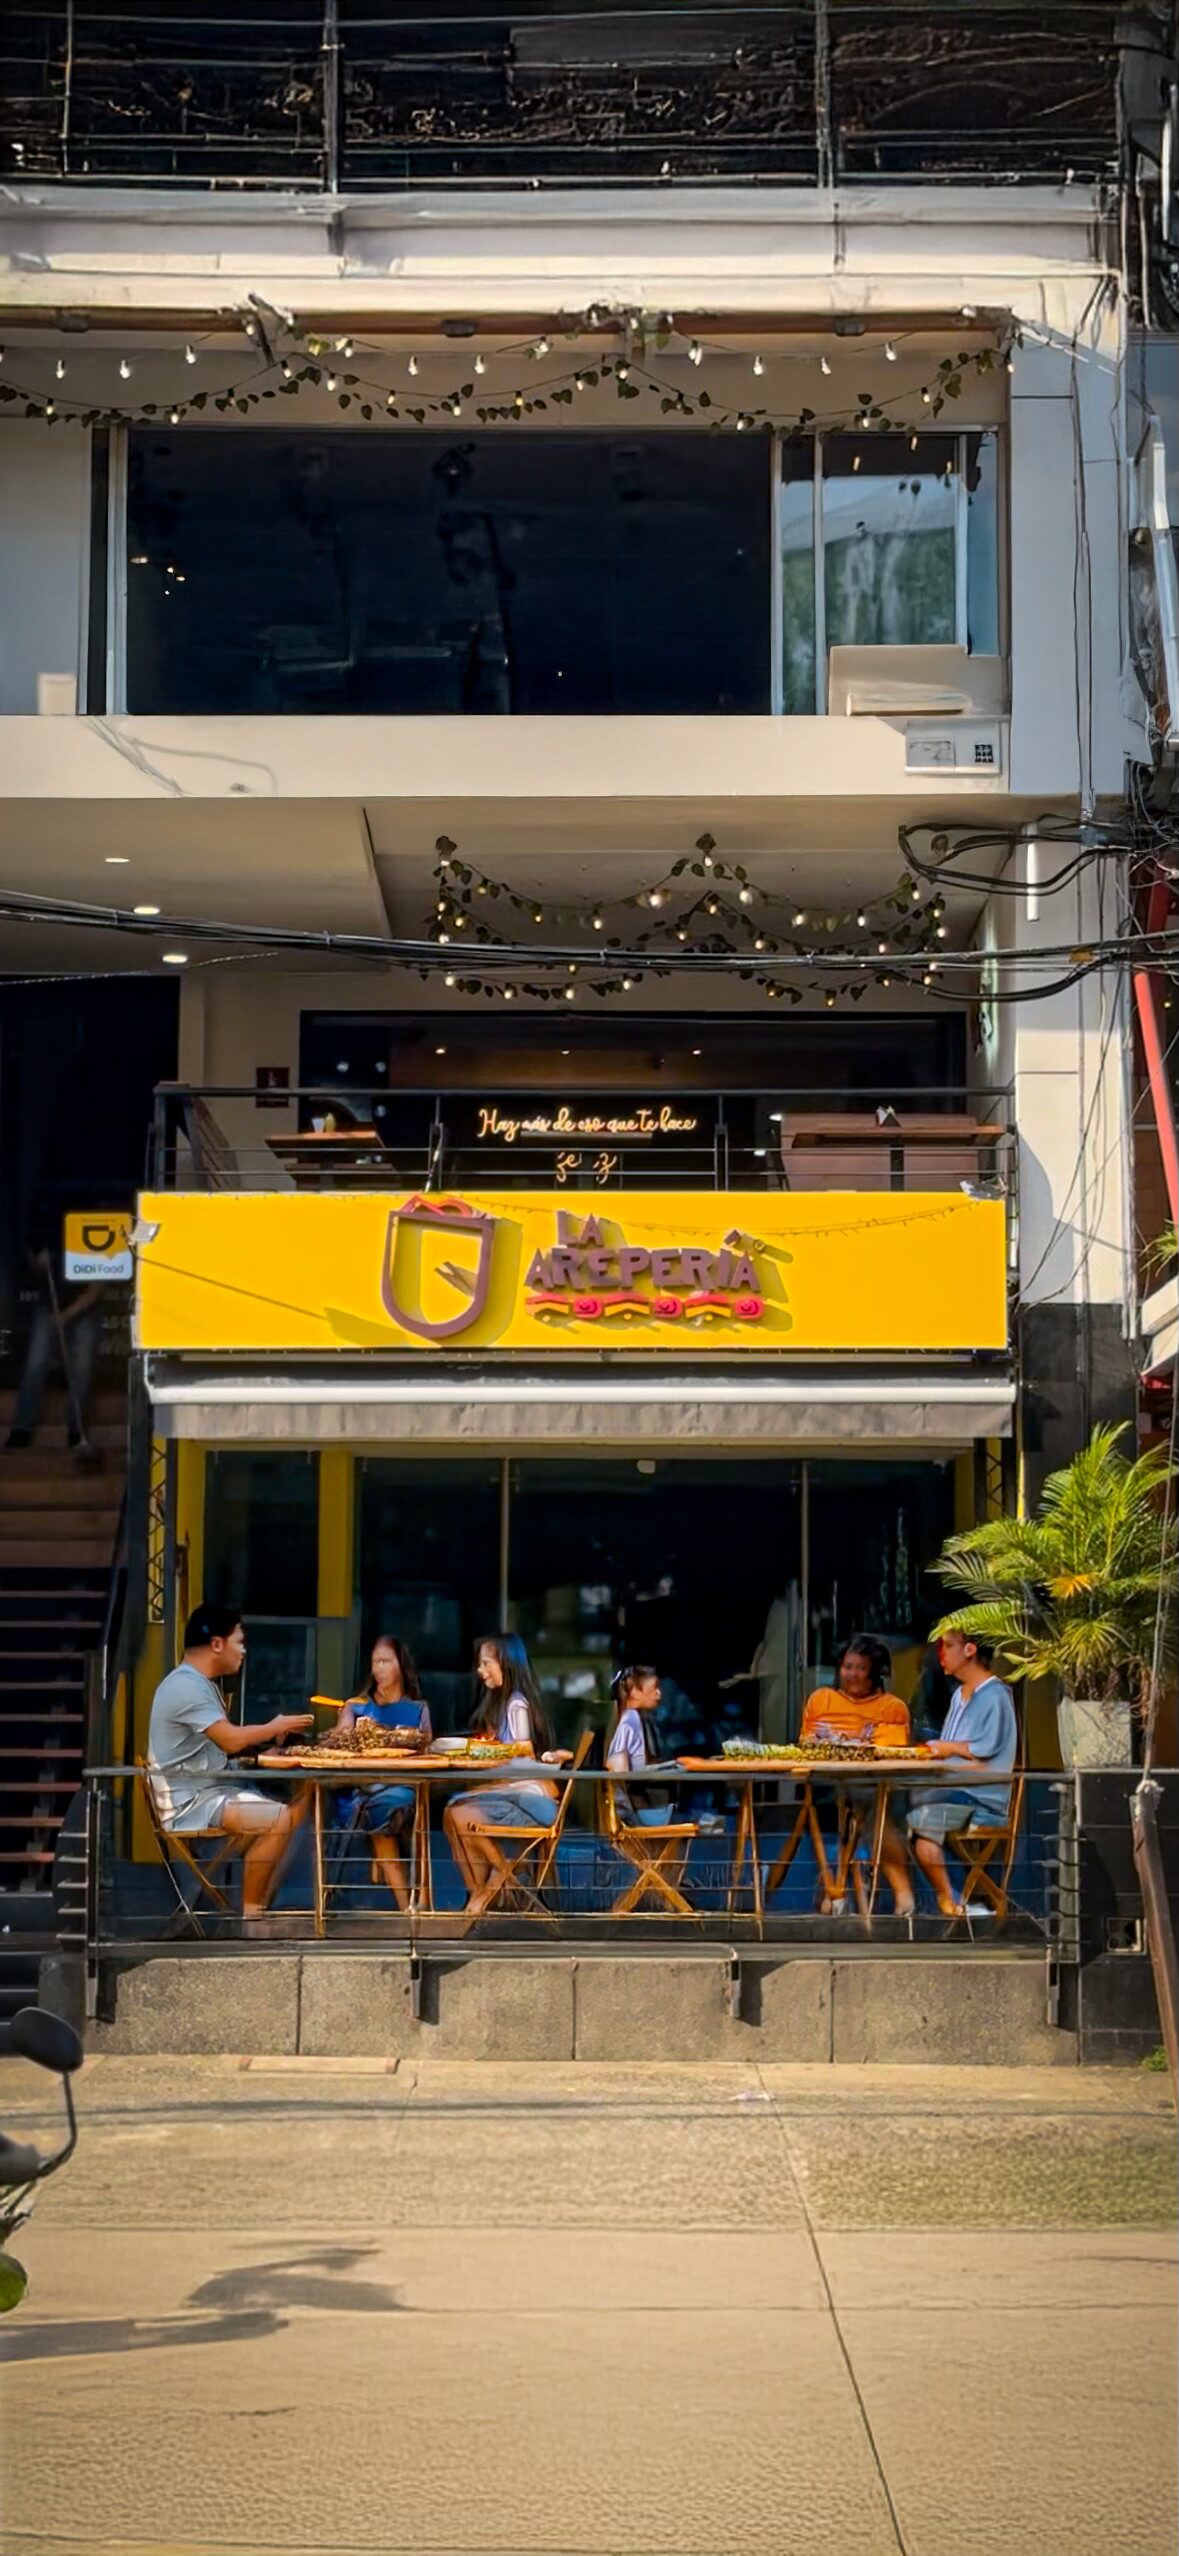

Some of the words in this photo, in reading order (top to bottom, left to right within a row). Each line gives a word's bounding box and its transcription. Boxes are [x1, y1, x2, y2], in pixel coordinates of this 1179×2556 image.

[477, 1108, 520, 1142] Haz
[552, 1106, 576, 1132] de
[606, 1119, 639, 1133] que
[659, 1106, 697, 1132] hace
[556, 1210, 605, 1247] LA
[73, 1264, 96, 1274] DiDi
[97, 1264, 124, 1274] Food
